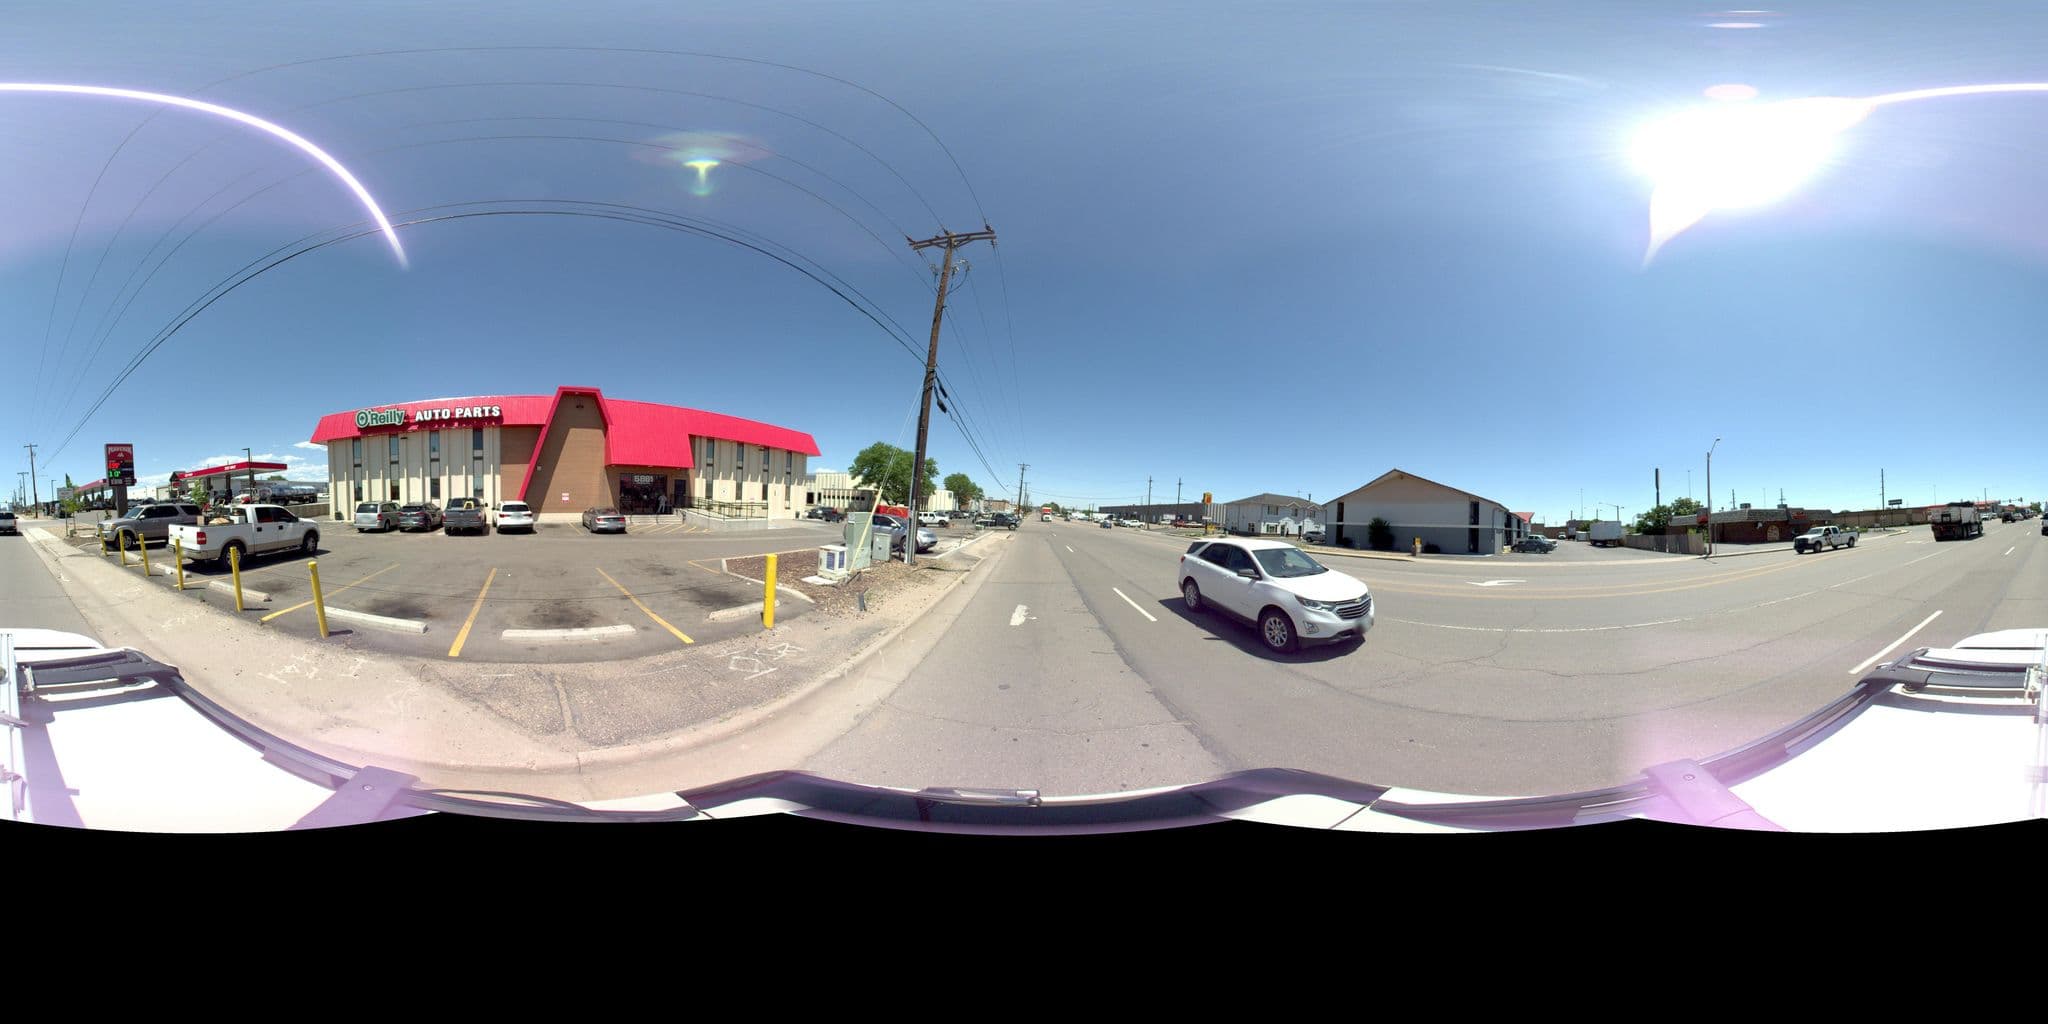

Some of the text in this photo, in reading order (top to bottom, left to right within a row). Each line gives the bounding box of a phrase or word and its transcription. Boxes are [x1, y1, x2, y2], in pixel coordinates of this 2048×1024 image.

[356, 406, 500, 428] O'Reilly AUTO PARTS
